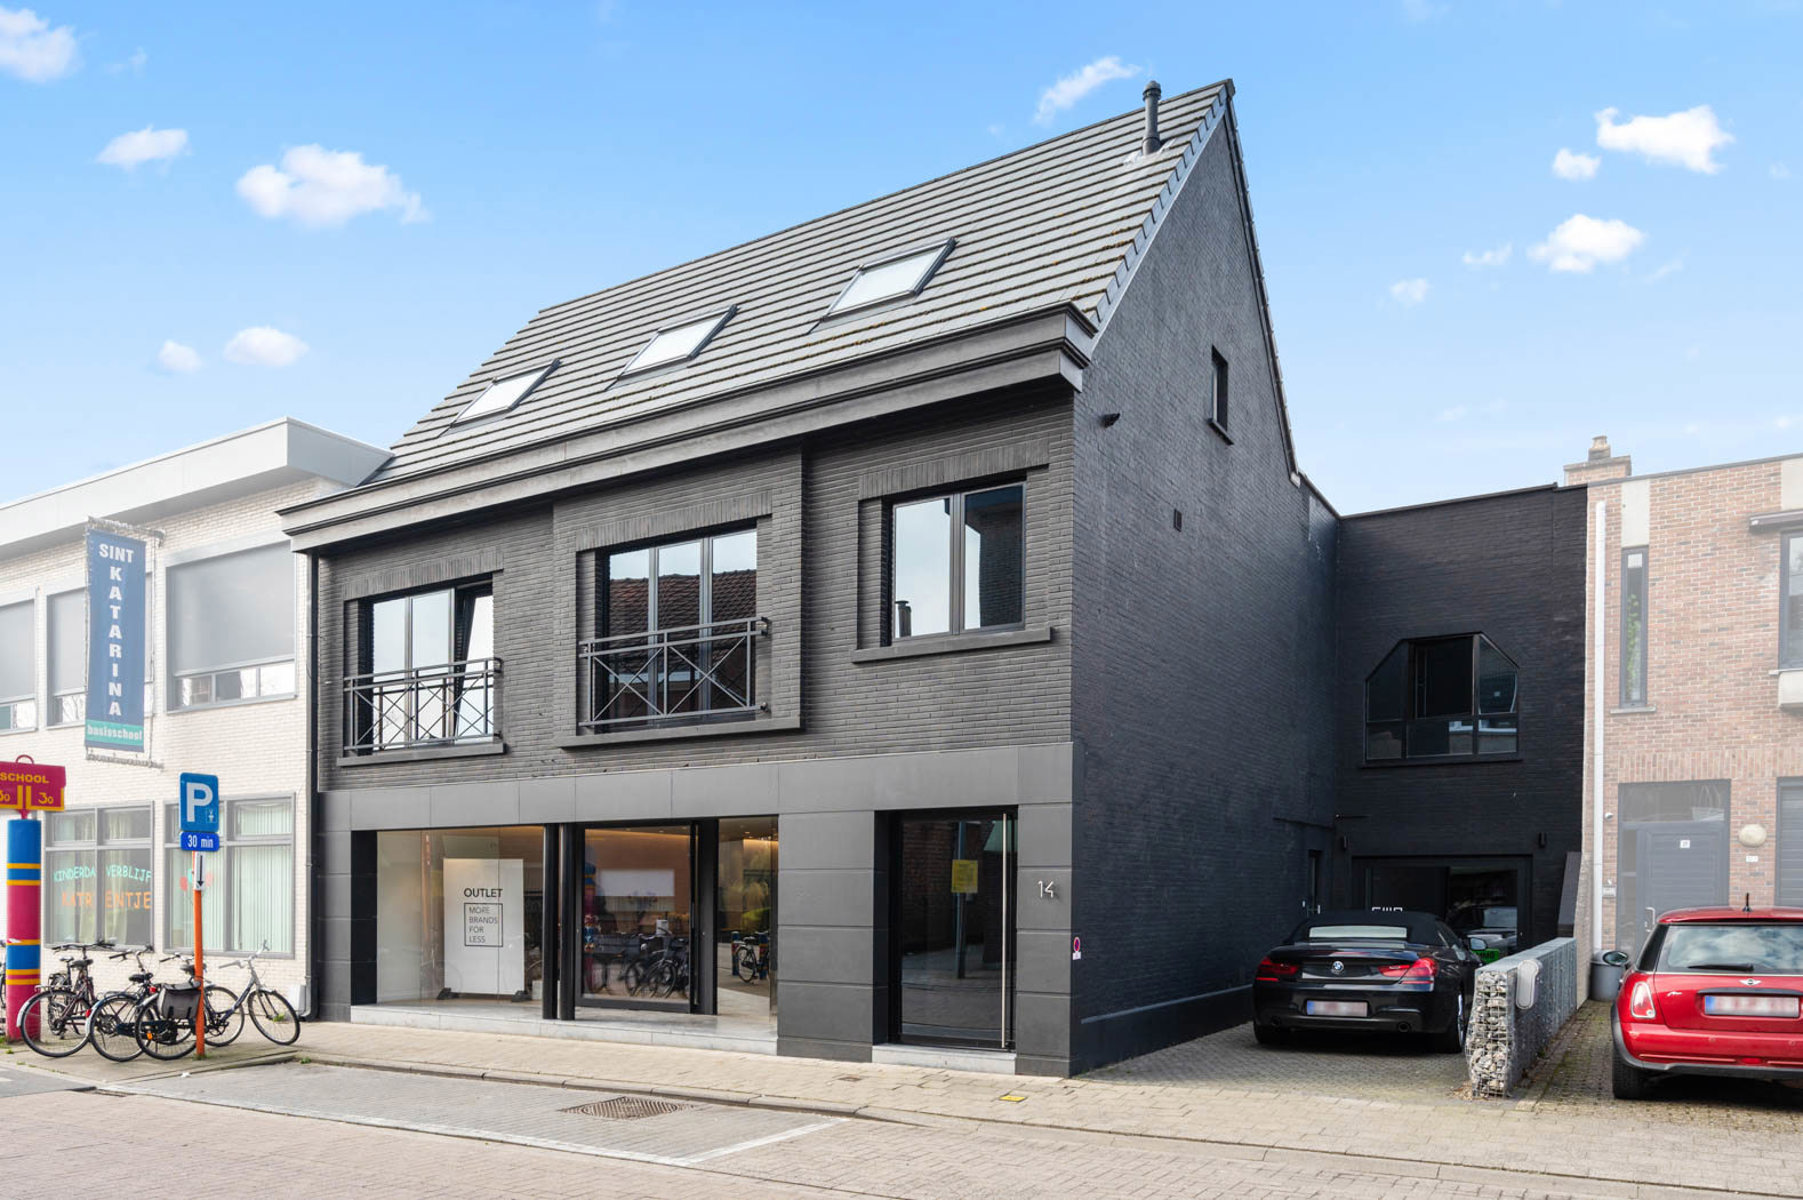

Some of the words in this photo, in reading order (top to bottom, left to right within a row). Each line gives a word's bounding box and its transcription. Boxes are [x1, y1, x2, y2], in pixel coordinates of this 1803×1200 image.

[99, 543, 134, 563] SINT
[109, 566, 122, 716] KATARINA
[0, 772, 50, 784] SCHOOL
[186, 782, 213, 822] P
[187, 835, 198, 848] 30
[200, 836, 214, 848] min
[463, 888, 503, 898] OUTLET
[1038, 880, 1055, 899] 14
[469, 906, 490, 914] MORE
[469, 916, 498, 924] BRANDS
[469, 926, 484, 934] FOR
[469, 936, 486, 944] LESS
